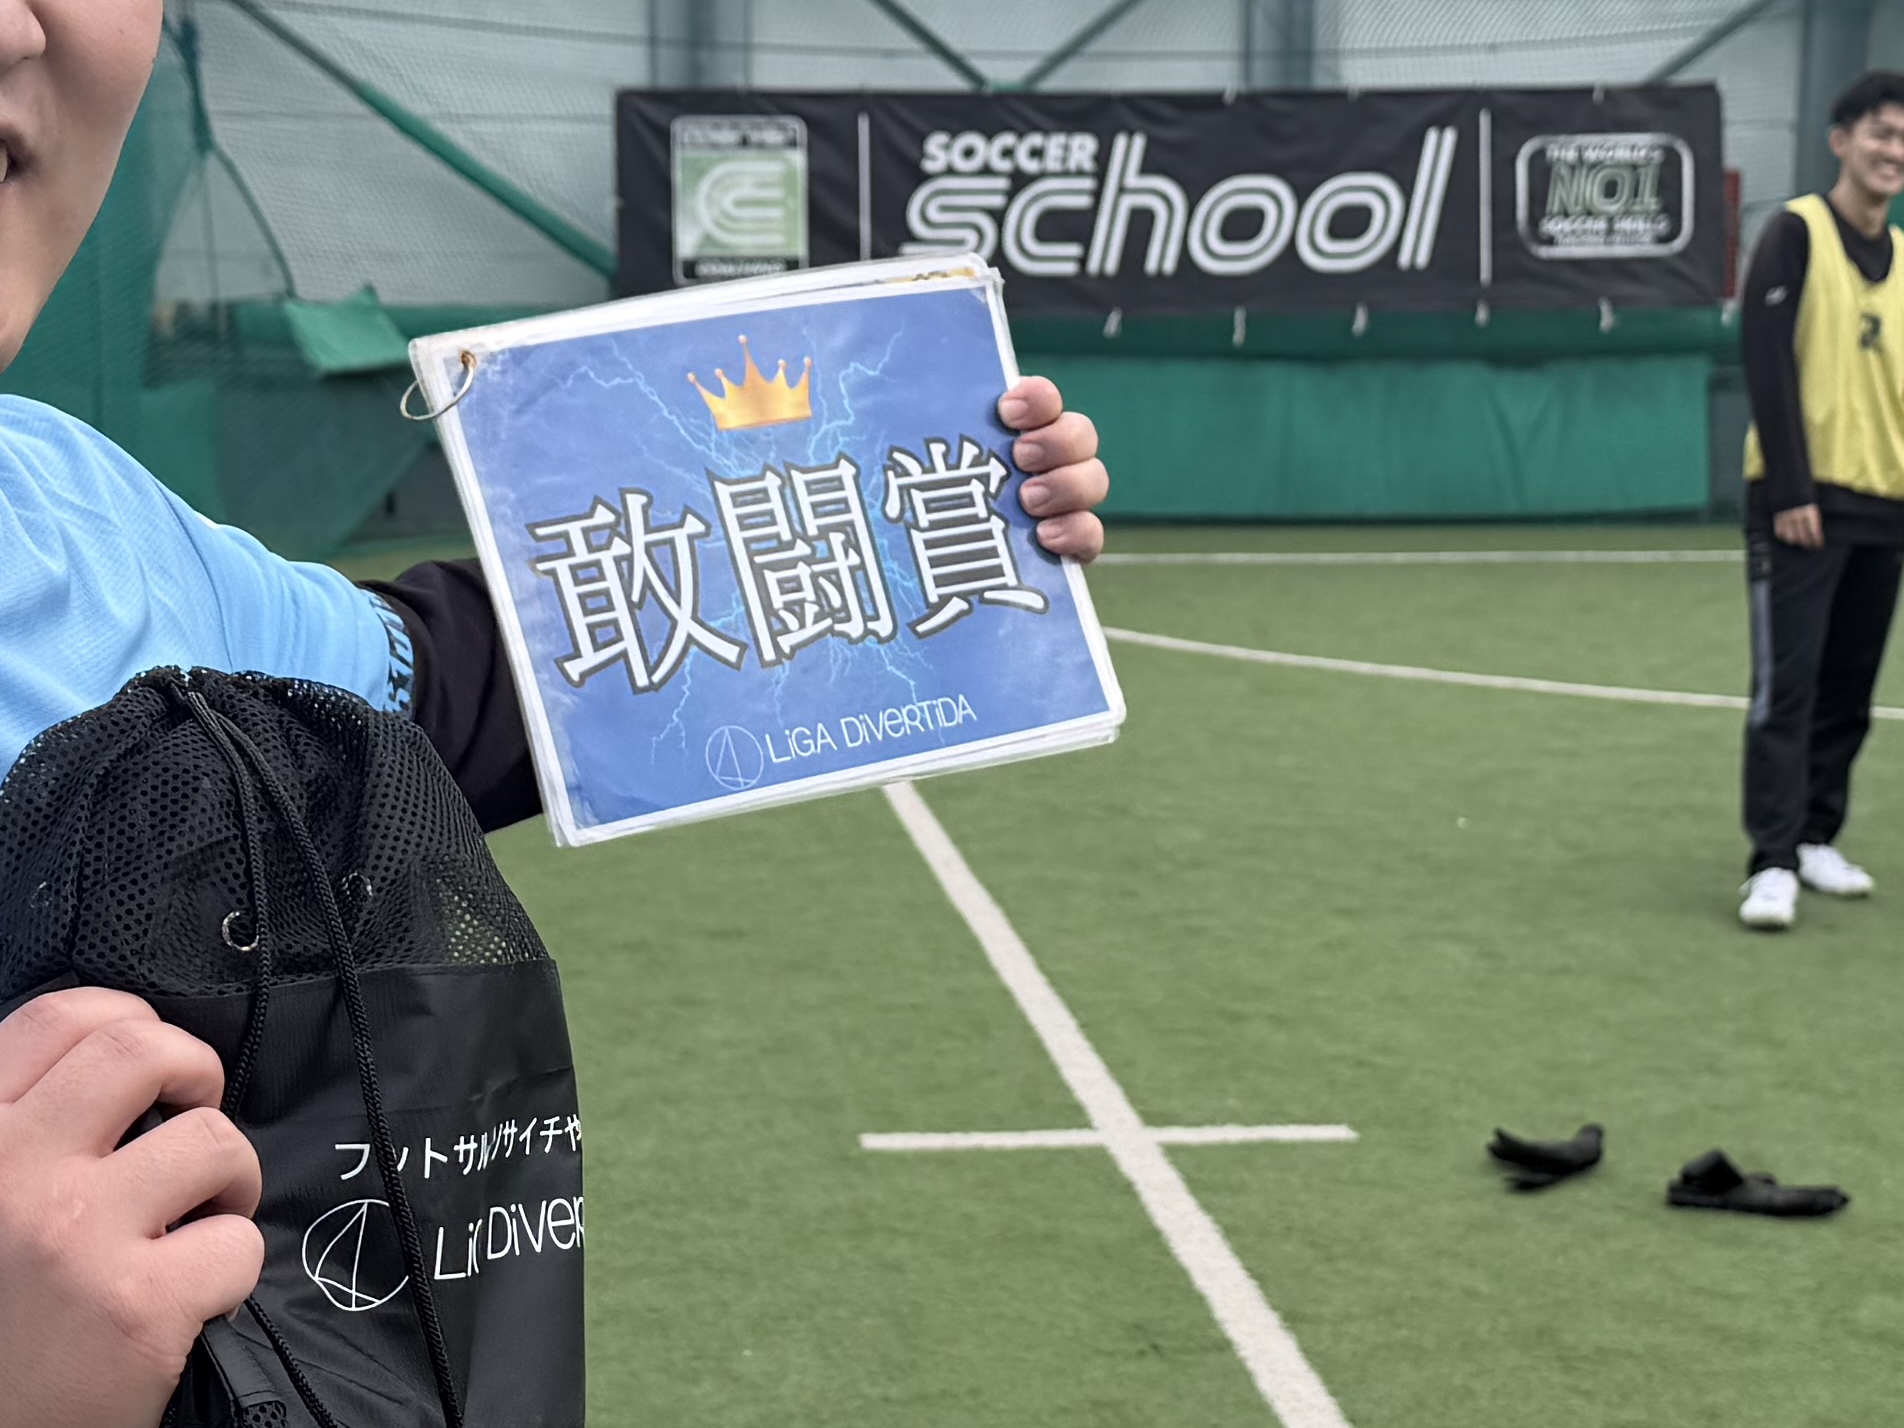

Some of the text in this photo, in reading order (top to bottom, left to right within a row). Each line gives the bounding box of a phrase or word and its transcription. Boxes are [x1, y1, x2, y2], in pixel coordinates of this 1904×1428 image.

[899, 126, 1458, 275] school
[920, 130, 1099, 174] SOCCER
[528, 436, 1049, 693] 敢闘賞
